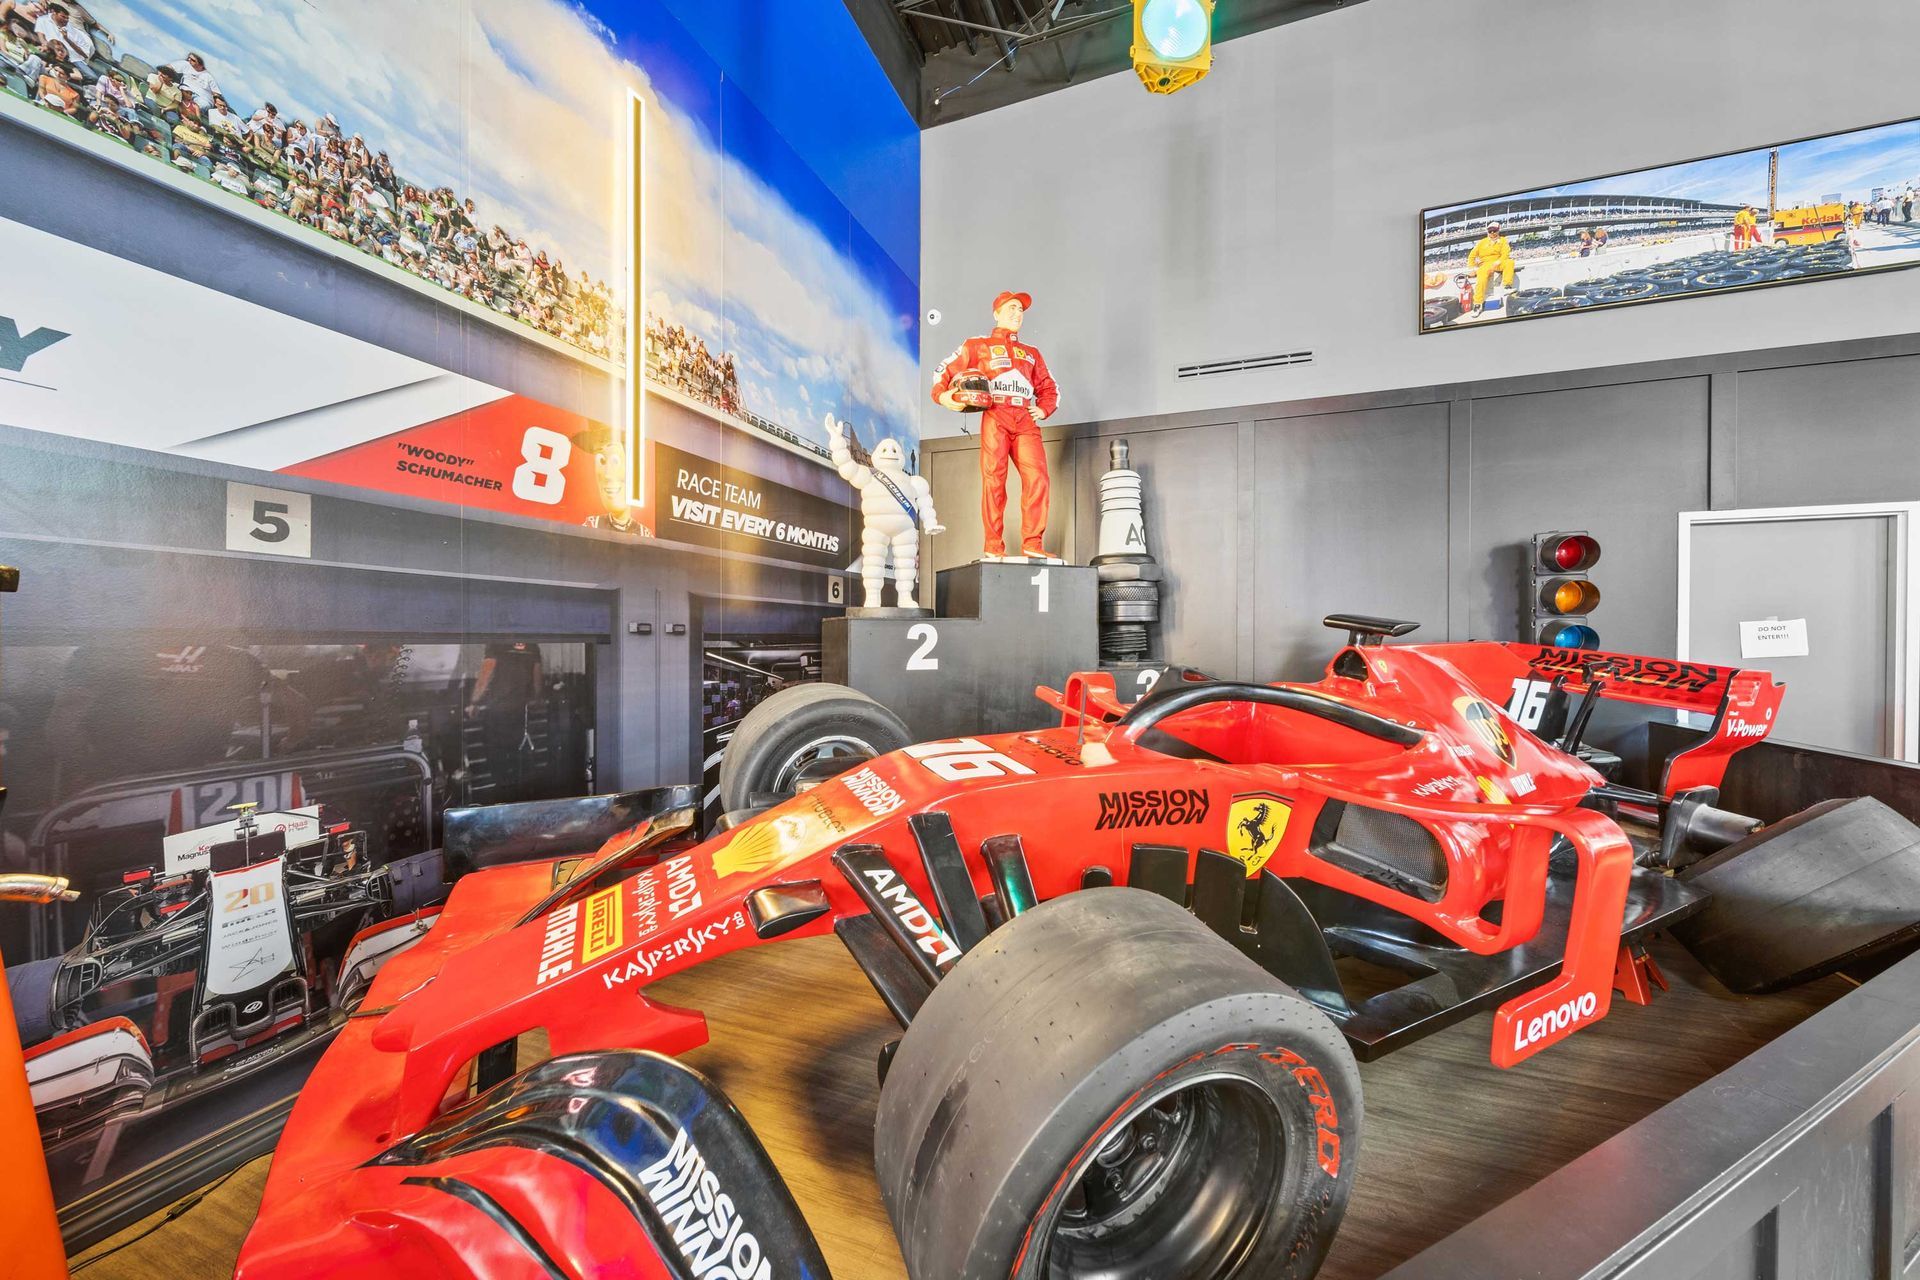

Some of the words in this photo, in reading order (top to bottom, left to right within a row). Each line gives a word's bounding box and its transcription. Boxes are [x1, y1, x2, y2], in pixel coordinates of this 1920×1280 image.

[1802, 213, 1842, 225] Kodak
[396, 460, 503, 491] SCHUMACHER
[512, 426, 572, 505] 8
[677, 468, 722, 499] RACE
[724, 483, 762, 510] TEAM
[876, 470, 911, 508] MICHELIN
[249, 499, 290, 543] 5
[671, 495, 722, 526] VISIT
[720, 508, 777, 538] EVERY
[776, 522, 786, 541] 6
[787, 525, 840, 552] MONTHS
[830, 581, 840, 599] 6
[1031, 568, 1049, 613] 1
[906, 623, 939, 671] 2
[1539, 647, 1718, 681] MISSION
[1508, 678, 1553, 730] 16
[1726, 718, 1768, 737] V-Power
[902, 738, 1038, 782] 16
[840, 771, 893, 817] WINNOW
[857, 766, 906, 812] MISSION
[1098, 788, 1210, 811] MISSION
[1095, 804, 1210, 831] WINNOW
[223, 882, 274, 913] 20
[863, 869, 938, 938] AMD
[536, 902, 579, 986] MAHLE
[590, 891, 615, 954] PIRELLI
[602, 927, 730, 990] KASPERSKY
[1514, 991, 1597, 1052] Lenovo
